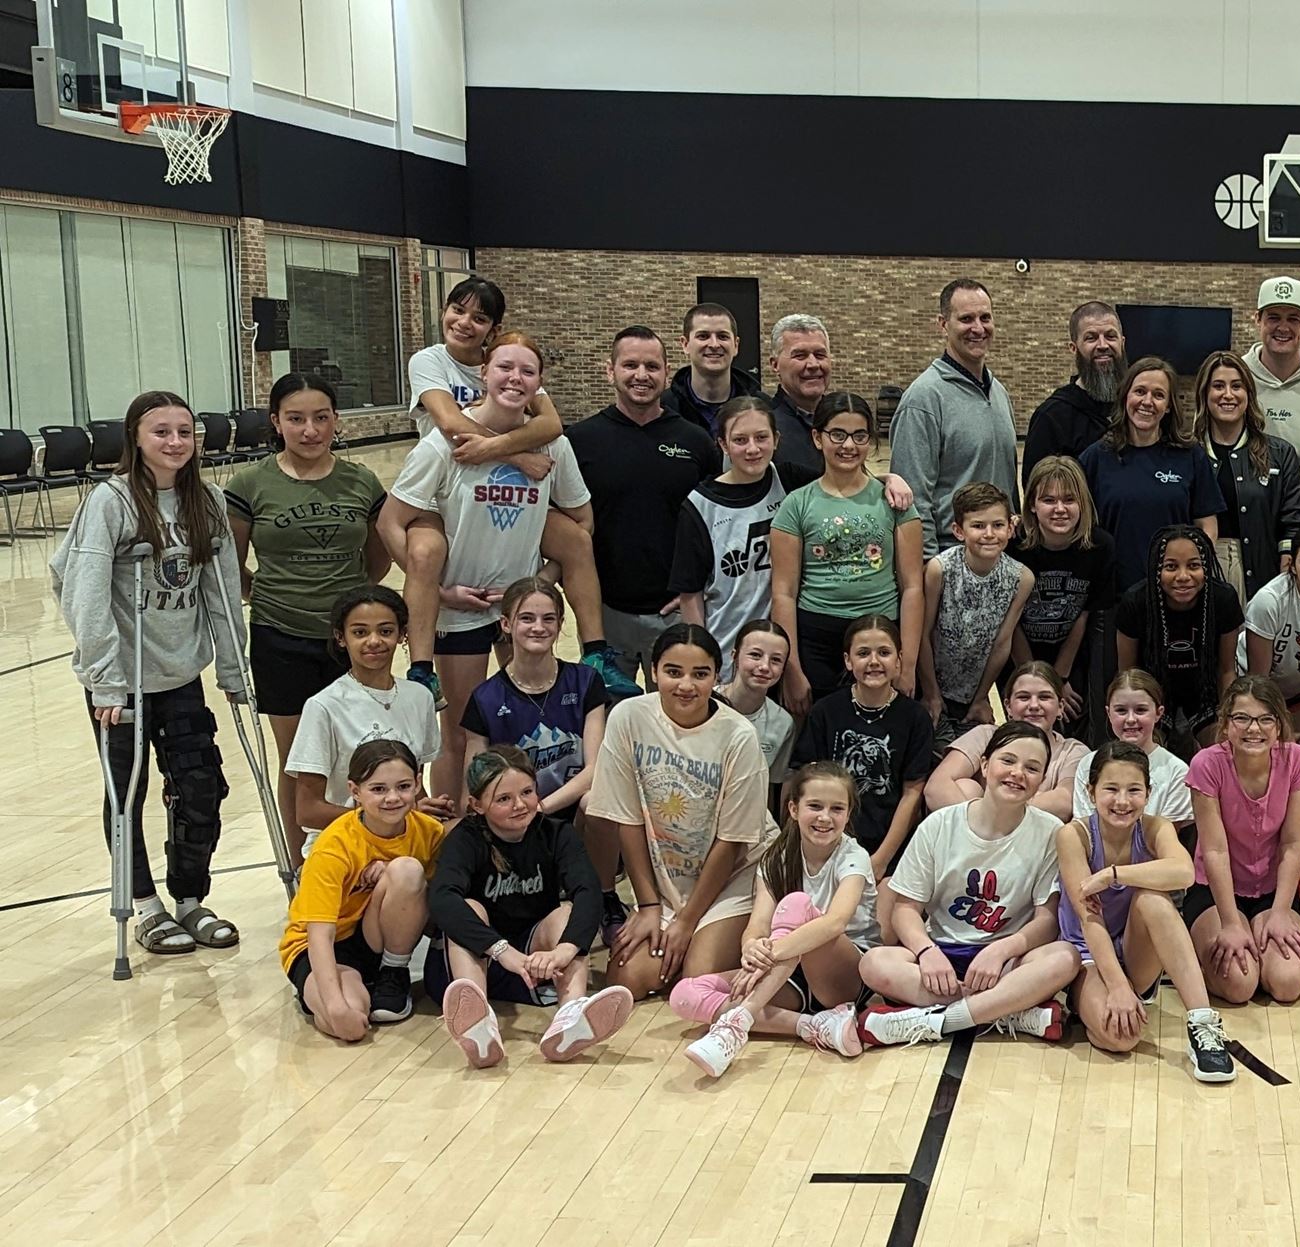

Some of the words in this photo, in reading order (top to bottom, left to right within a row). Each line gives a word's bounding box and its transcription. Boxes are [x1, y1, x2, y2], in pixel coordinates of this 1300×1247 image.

[63, 73, 73, 102] 8
[474, 485, 539, 504] SCOTS
[274, 503, 356, 528] GUESS
[646, 745, 662, 766] TO
[665, 750, 685, 770] THE
[484, 863, 544, 902] Untamed
